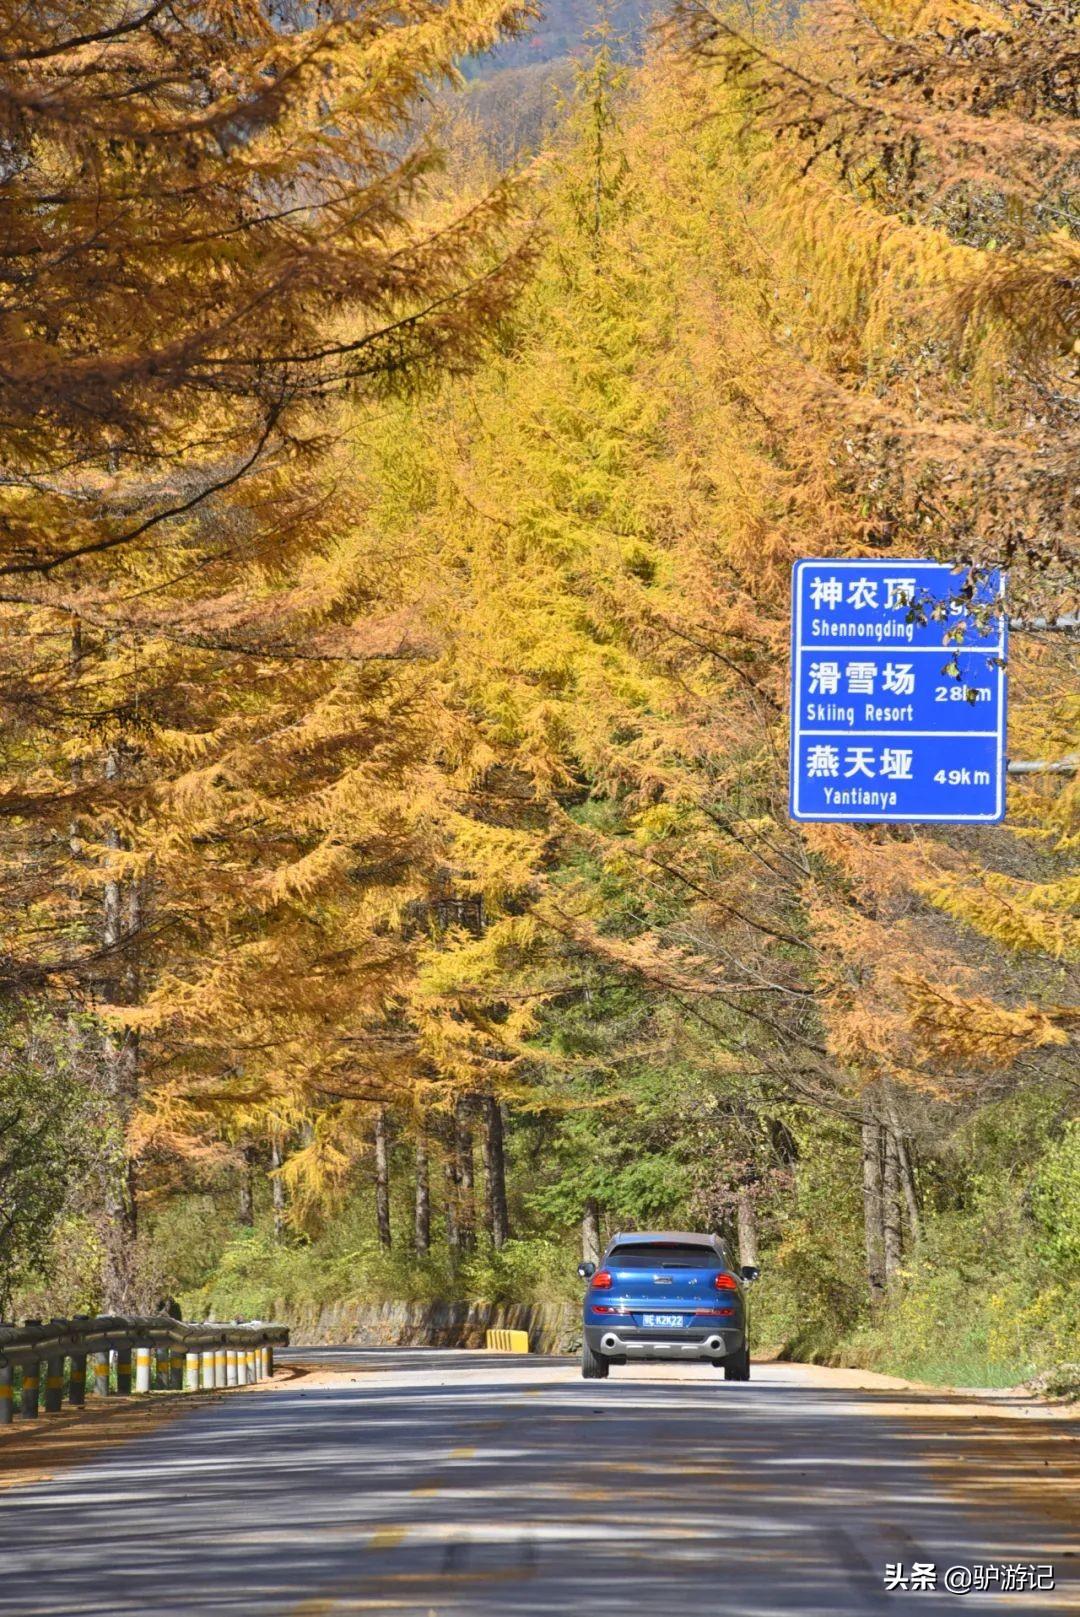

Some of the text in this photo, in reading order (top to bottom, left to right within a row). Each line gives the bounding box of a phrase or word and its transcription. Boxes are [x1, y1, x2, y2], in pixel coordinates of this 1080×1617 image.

[809, 576, 917, 610] 神农顶
[812, 618, 914, 642] Shennongding
[808, 662, 915, 695] 滑雪场
[807, 703, 913, 726] Skiing Resort
[806, 744, 913, 780] 燕天垭
[933, 768, 990, 785] 49km
[824, 787, 897, 810] Yantianya
